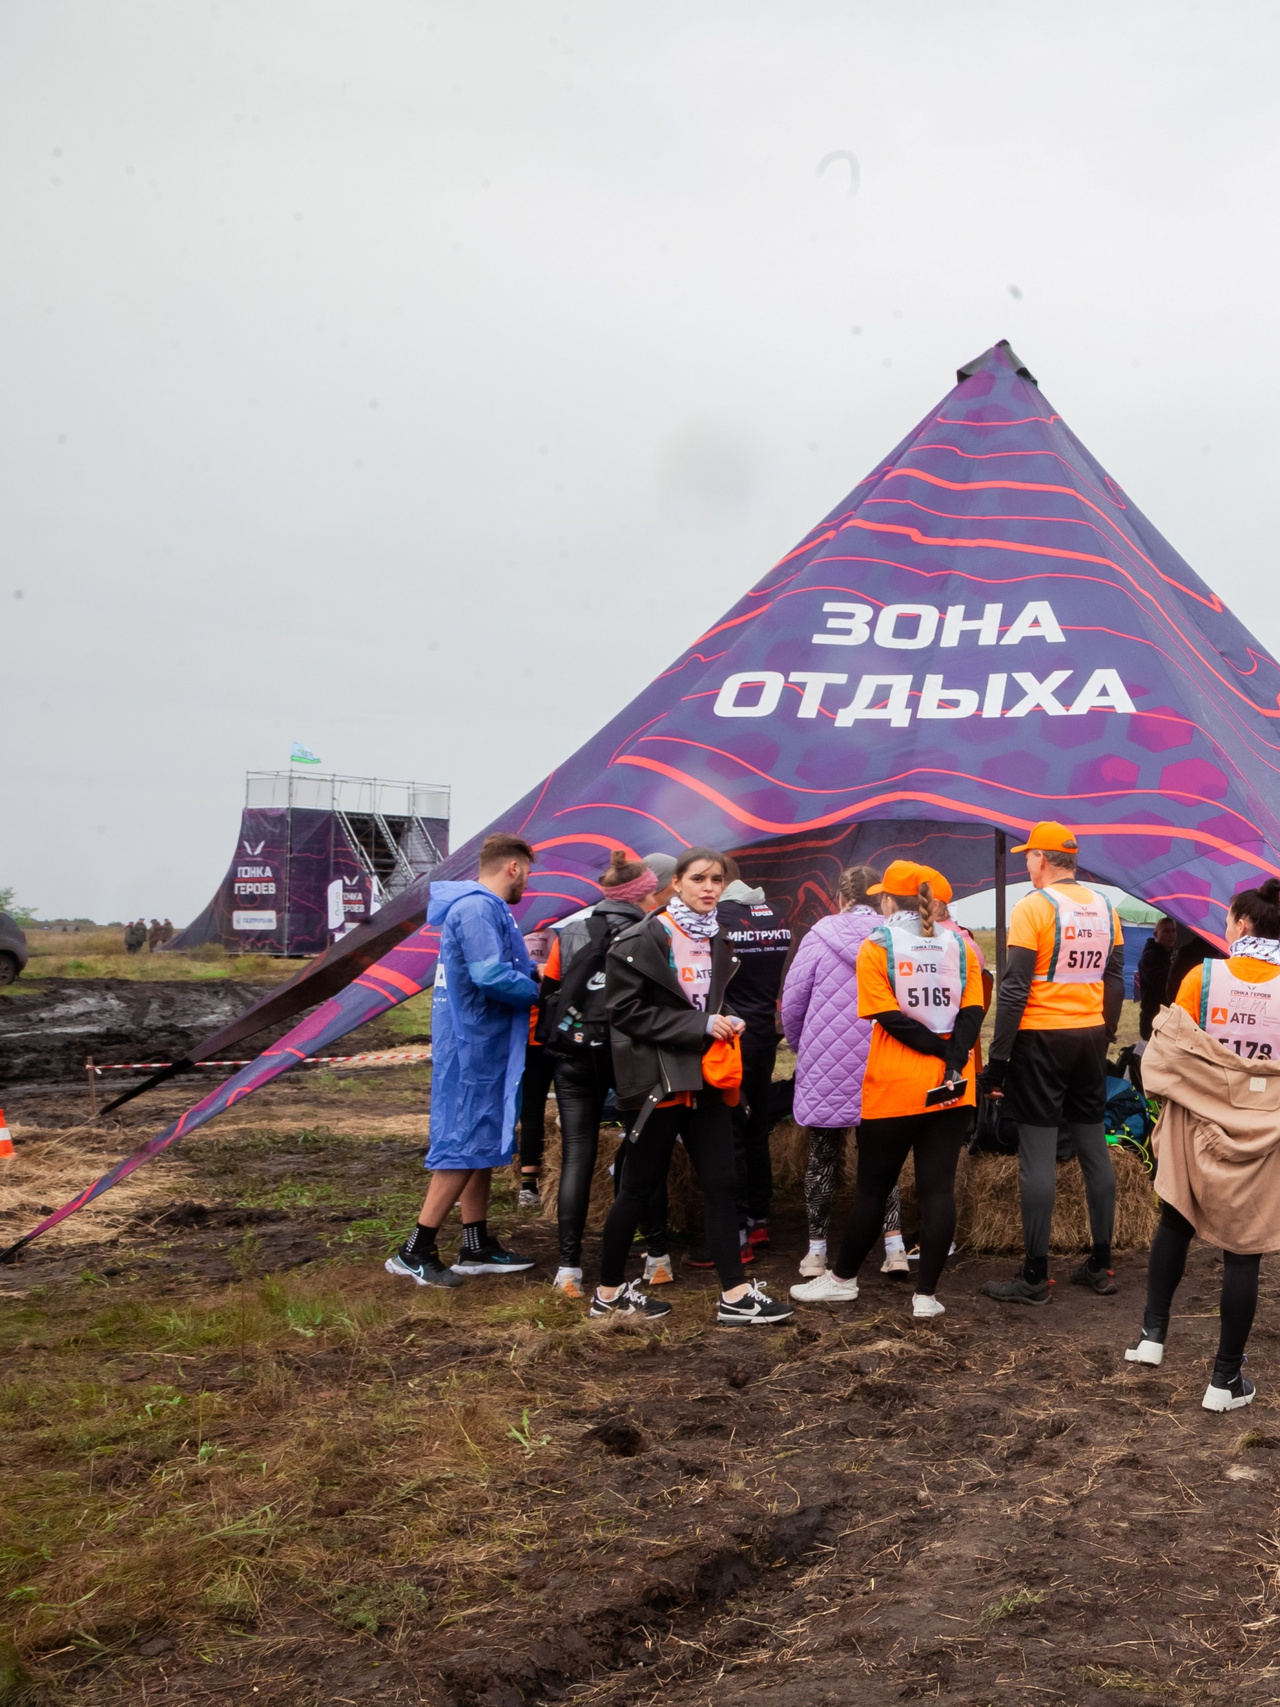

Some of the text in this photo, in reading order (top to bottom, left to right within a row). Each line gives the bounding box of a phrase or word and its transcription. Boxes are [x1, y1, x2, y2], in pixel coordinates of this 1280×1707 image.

[811, 600, 1066, 650] ЗОНА
[713, 668, 1138, 727] ОТДЫХА
[237, 866, 273, 878] ГОНКА
[234, 882, 276, 894] ГЕРОЕВ
[1077, 929, 1093, 938] АТБ
[1067, 950, 1103, 968] 5172
[916, 963, 937, 973] АТБ
[908, 987, 951, 1007] 5165
[1230, 1012, 1256, 1025] АТБ
[1218, 1038, 1272, 1060] 178
